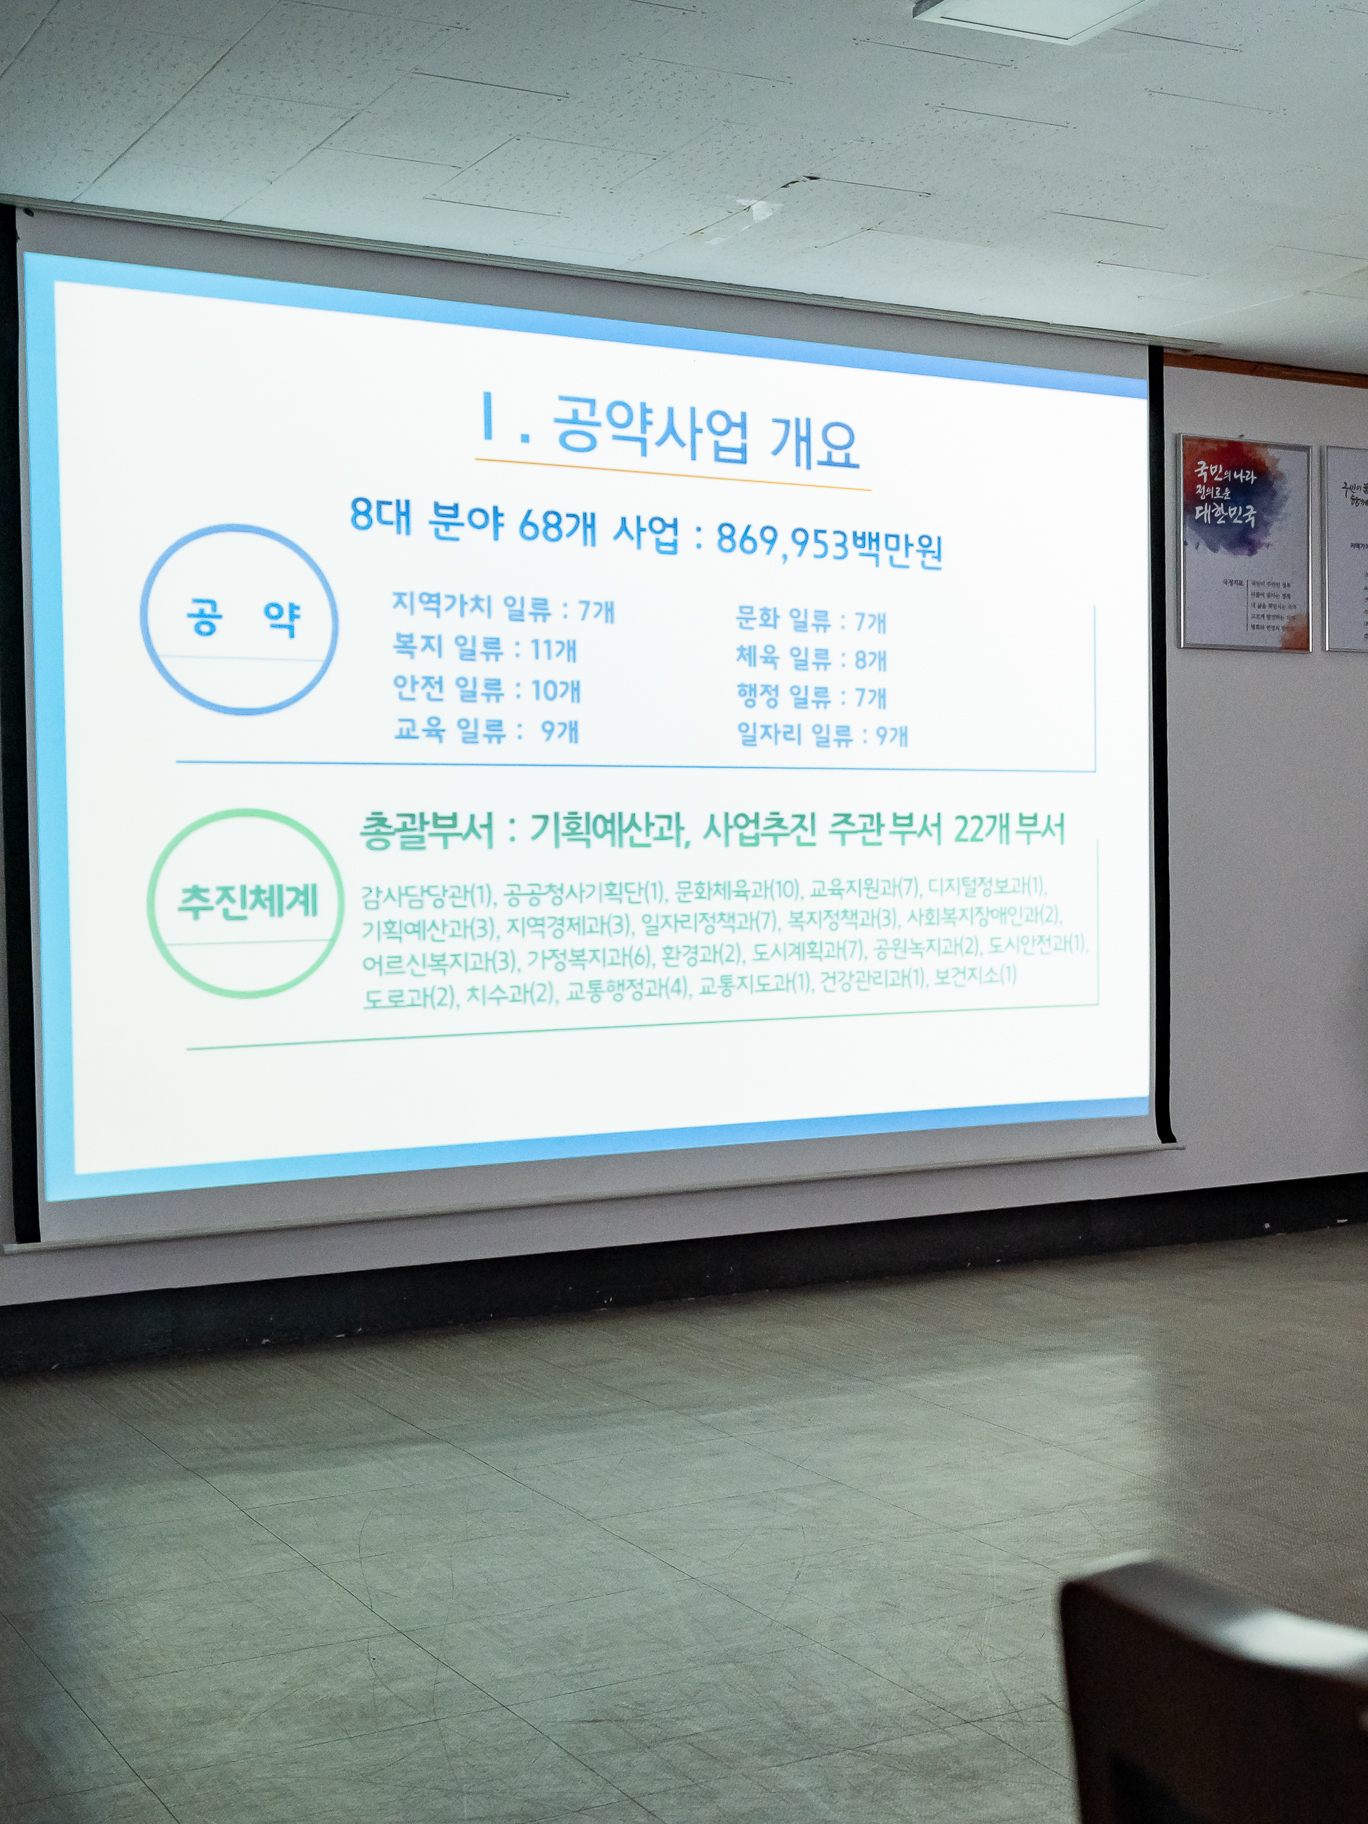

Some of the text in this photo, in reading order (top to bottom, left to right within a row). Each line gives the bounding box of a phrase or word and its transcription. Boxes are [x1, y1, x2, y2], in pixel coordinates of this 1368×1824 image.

[554, 395, 747, 464] 공약사업
[771, 417, 860, 470] 개요
[1194, 460, 1257, 485] 국민의 나라
[1195, 483, 1231, 500] 정의로운
[1195, 502, 1257, 528] 대한민국
[351, 497, 410, 536] 8대
[429, 501, 504, 541] 분야
[519, 509, 596, 547] 68개
[613, 515, 678, 555] 사업
[718, 522, 942, 570] 869,953백만원
[187, 599, 301, 639] 공 약
[393, 591, 491, 619] 지역가치
[504, 596, 552, 623] 일류
[579, 600, 614, 624] 7개
[736, 605, 780, 630] 문화
[789, 608, 831, 633] 일류
[855, 612, 886, 634] 7개
[393, 632, 442, 659] 복지
[454, 635, 503, 662] 일류
[531, 639, 576, 663] 11개
[736, 644, 780, 670] 체육
[790, 646, 831, 671] 일류
[855, 650, 886, 672] 8개
[394, 675, 444, 702] 안전
[455, 676, 504, 703] 일류
[532, 680, 580, 703] 10개
[737, 682, 779, 709] 행정
[790, 685, 831, 709] 일류
[855, 688, 886, 709] 7개
[395, 716, 446, 743] 교육
[457, 718, 506, 744] 일류
[541, 720, 578, 744] 9개
[738, 722, 801, 747] 일자리
[812, 724, 853, 748] 일류
[876, 726, 908, 747] 9개
[360, 811, 493, 851] 총괄부서
[531, 811, 690, 849] 기획예산과,
[178, 883, 318, 921] 추진체계
[362, 875, 1047, 910] 감사담당관(1), 공공청사기획단(1), 문화체육과(10), 교육지원과(7), 디지털정보과(1),
[363, 904, 1062, 943] 기획예산과(3), 지역경제과(3), 일자리정책과(7), 복지정책과(3), 사회복지장애인과(2),
[363, 933, 1088, 977] 어르신복지과(3), 가정복지과(6), 환경과(2), 도시계획과(7), 공원녹지과(2), 도시안전과(1),
[364, 964, 1017, 1010] 도로과(2), 치수과(2), 교통행정과(4), 교통지도과(1), 건강관리과(1), 보건지소(1)
